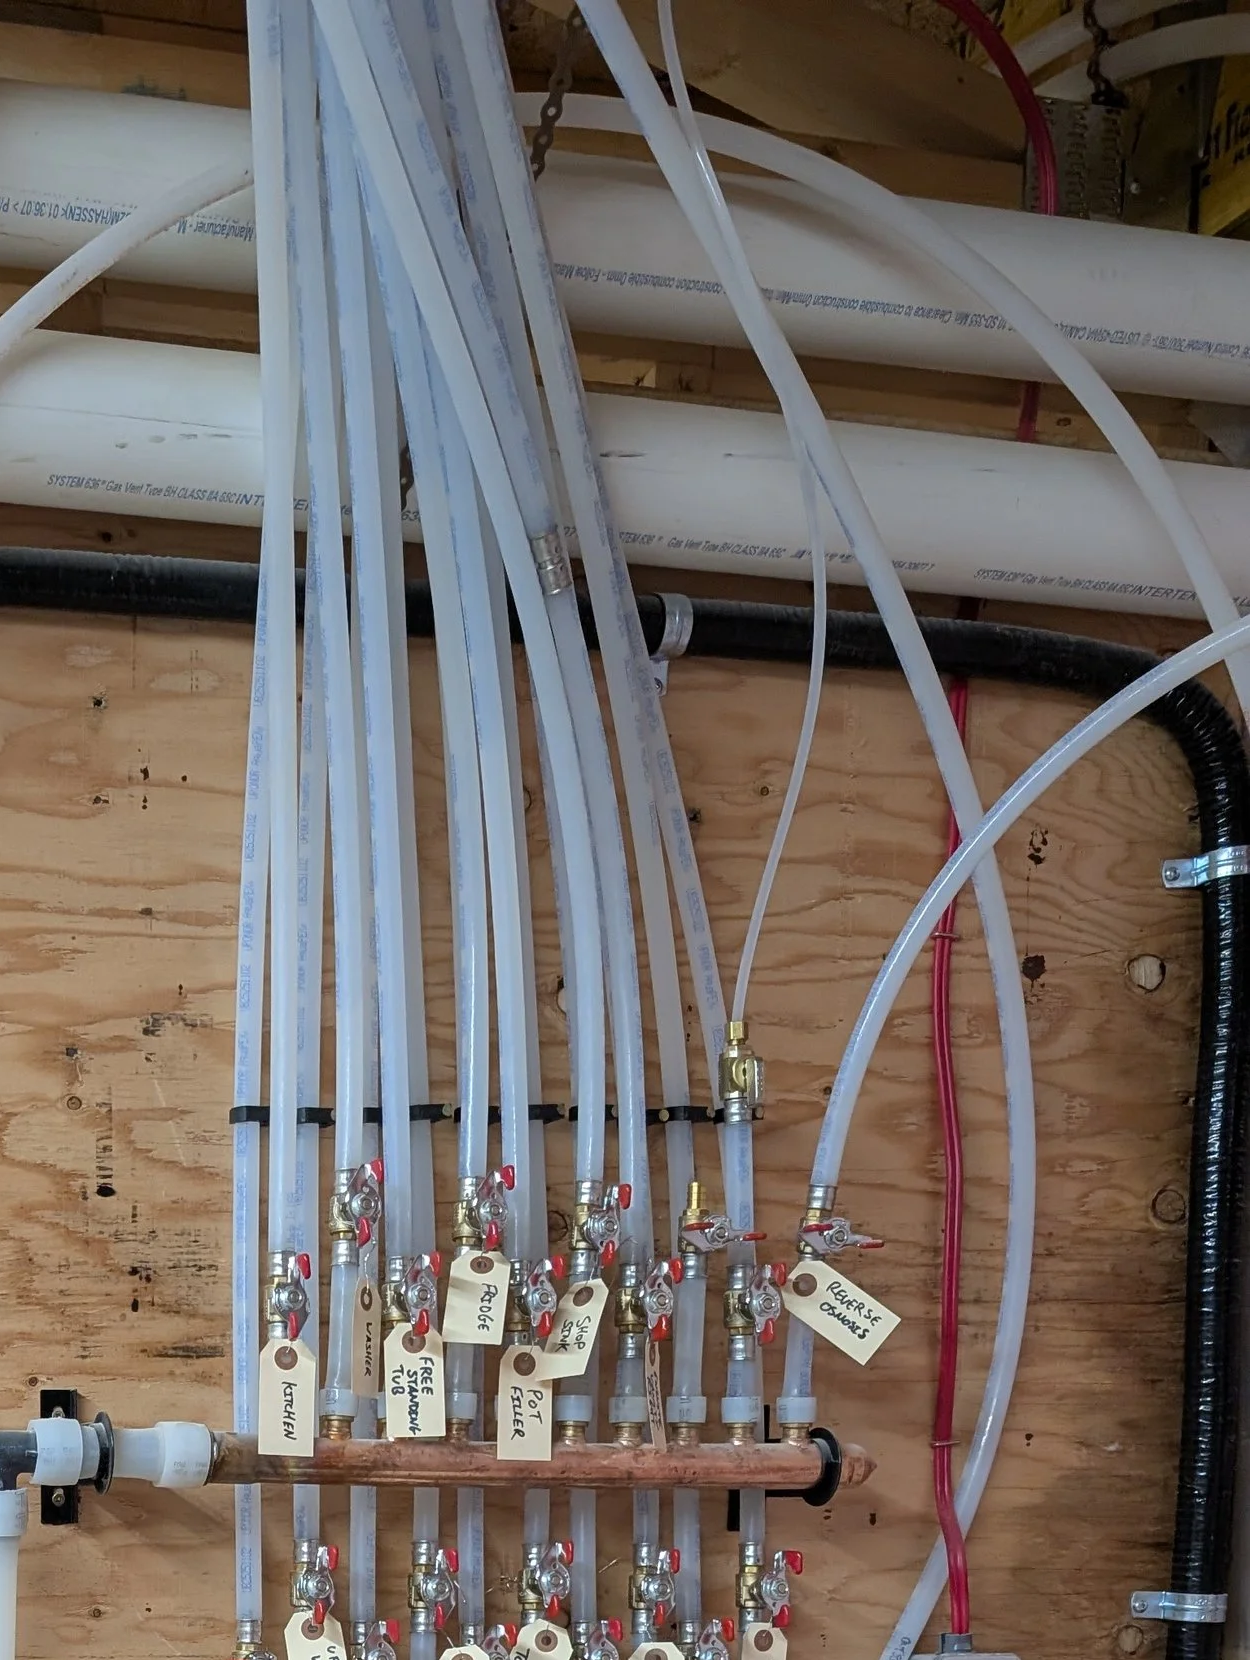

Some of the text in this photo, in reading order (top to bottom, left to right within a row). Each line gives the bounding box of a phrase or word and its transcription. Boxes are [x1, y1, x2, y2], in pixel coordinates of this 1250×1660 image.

[575, 266, 601, 283] Follow
[628, 272, 675, 291] combustible
[676, 277, 723, 295] construction
[814, 293, 859, 311] construction
[47, 473, 208, 501] SYSTEM Gas Vent Type BH CLASS
[973, 568, 1006, 582] SYSTEM
[476, 1282, 499, 1333] FRIDGE
[825, 1280, 882, 1327] REVERSE
[363, 1321, 373, 1378] WASHER
[555, 1318, 574, 1353] SINK
[574, 1315, 592, 1351] SHOP
[390, 1364, 405, 1397] TUB
[418, 1356, 435, 1396] FREE
[281, 1380, 298, 1441] KITCHEN
[406, 1368, 422, 1437] STANDING
[510, 1385, 526, 1441] FILLER
[526, 1388, 544, 1425] POT
